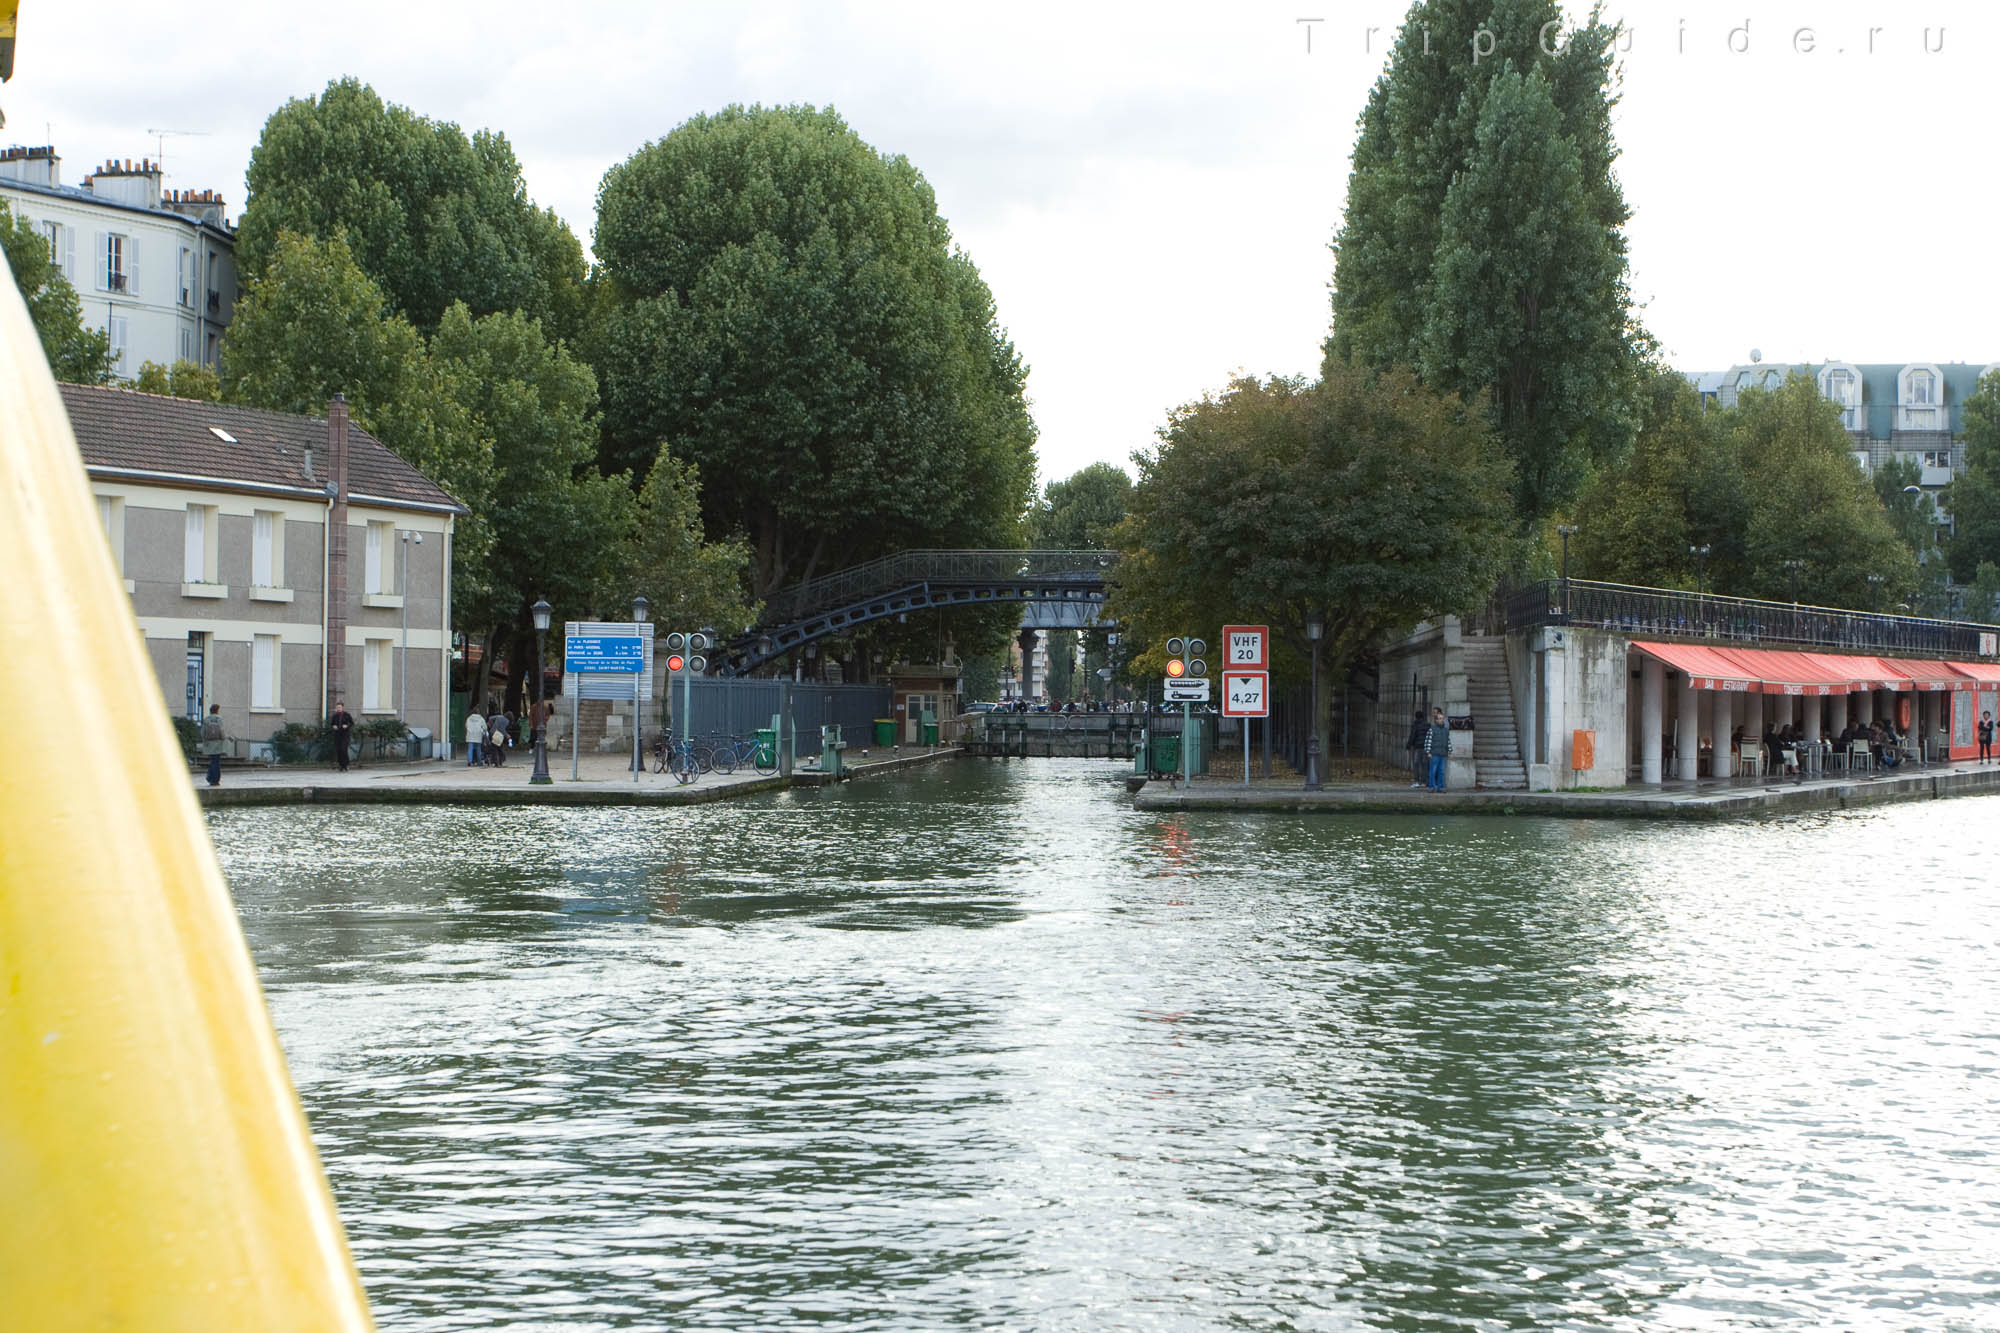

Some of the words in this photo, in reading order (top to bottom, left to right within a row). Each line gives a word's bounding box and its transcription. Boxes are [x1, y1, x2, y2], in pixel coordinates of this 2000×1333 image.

[1233, 636, 1258, 646] VHF
[1238, 650, 1254, 660] 20
[1232, 693, 1259, 704] 4,27
